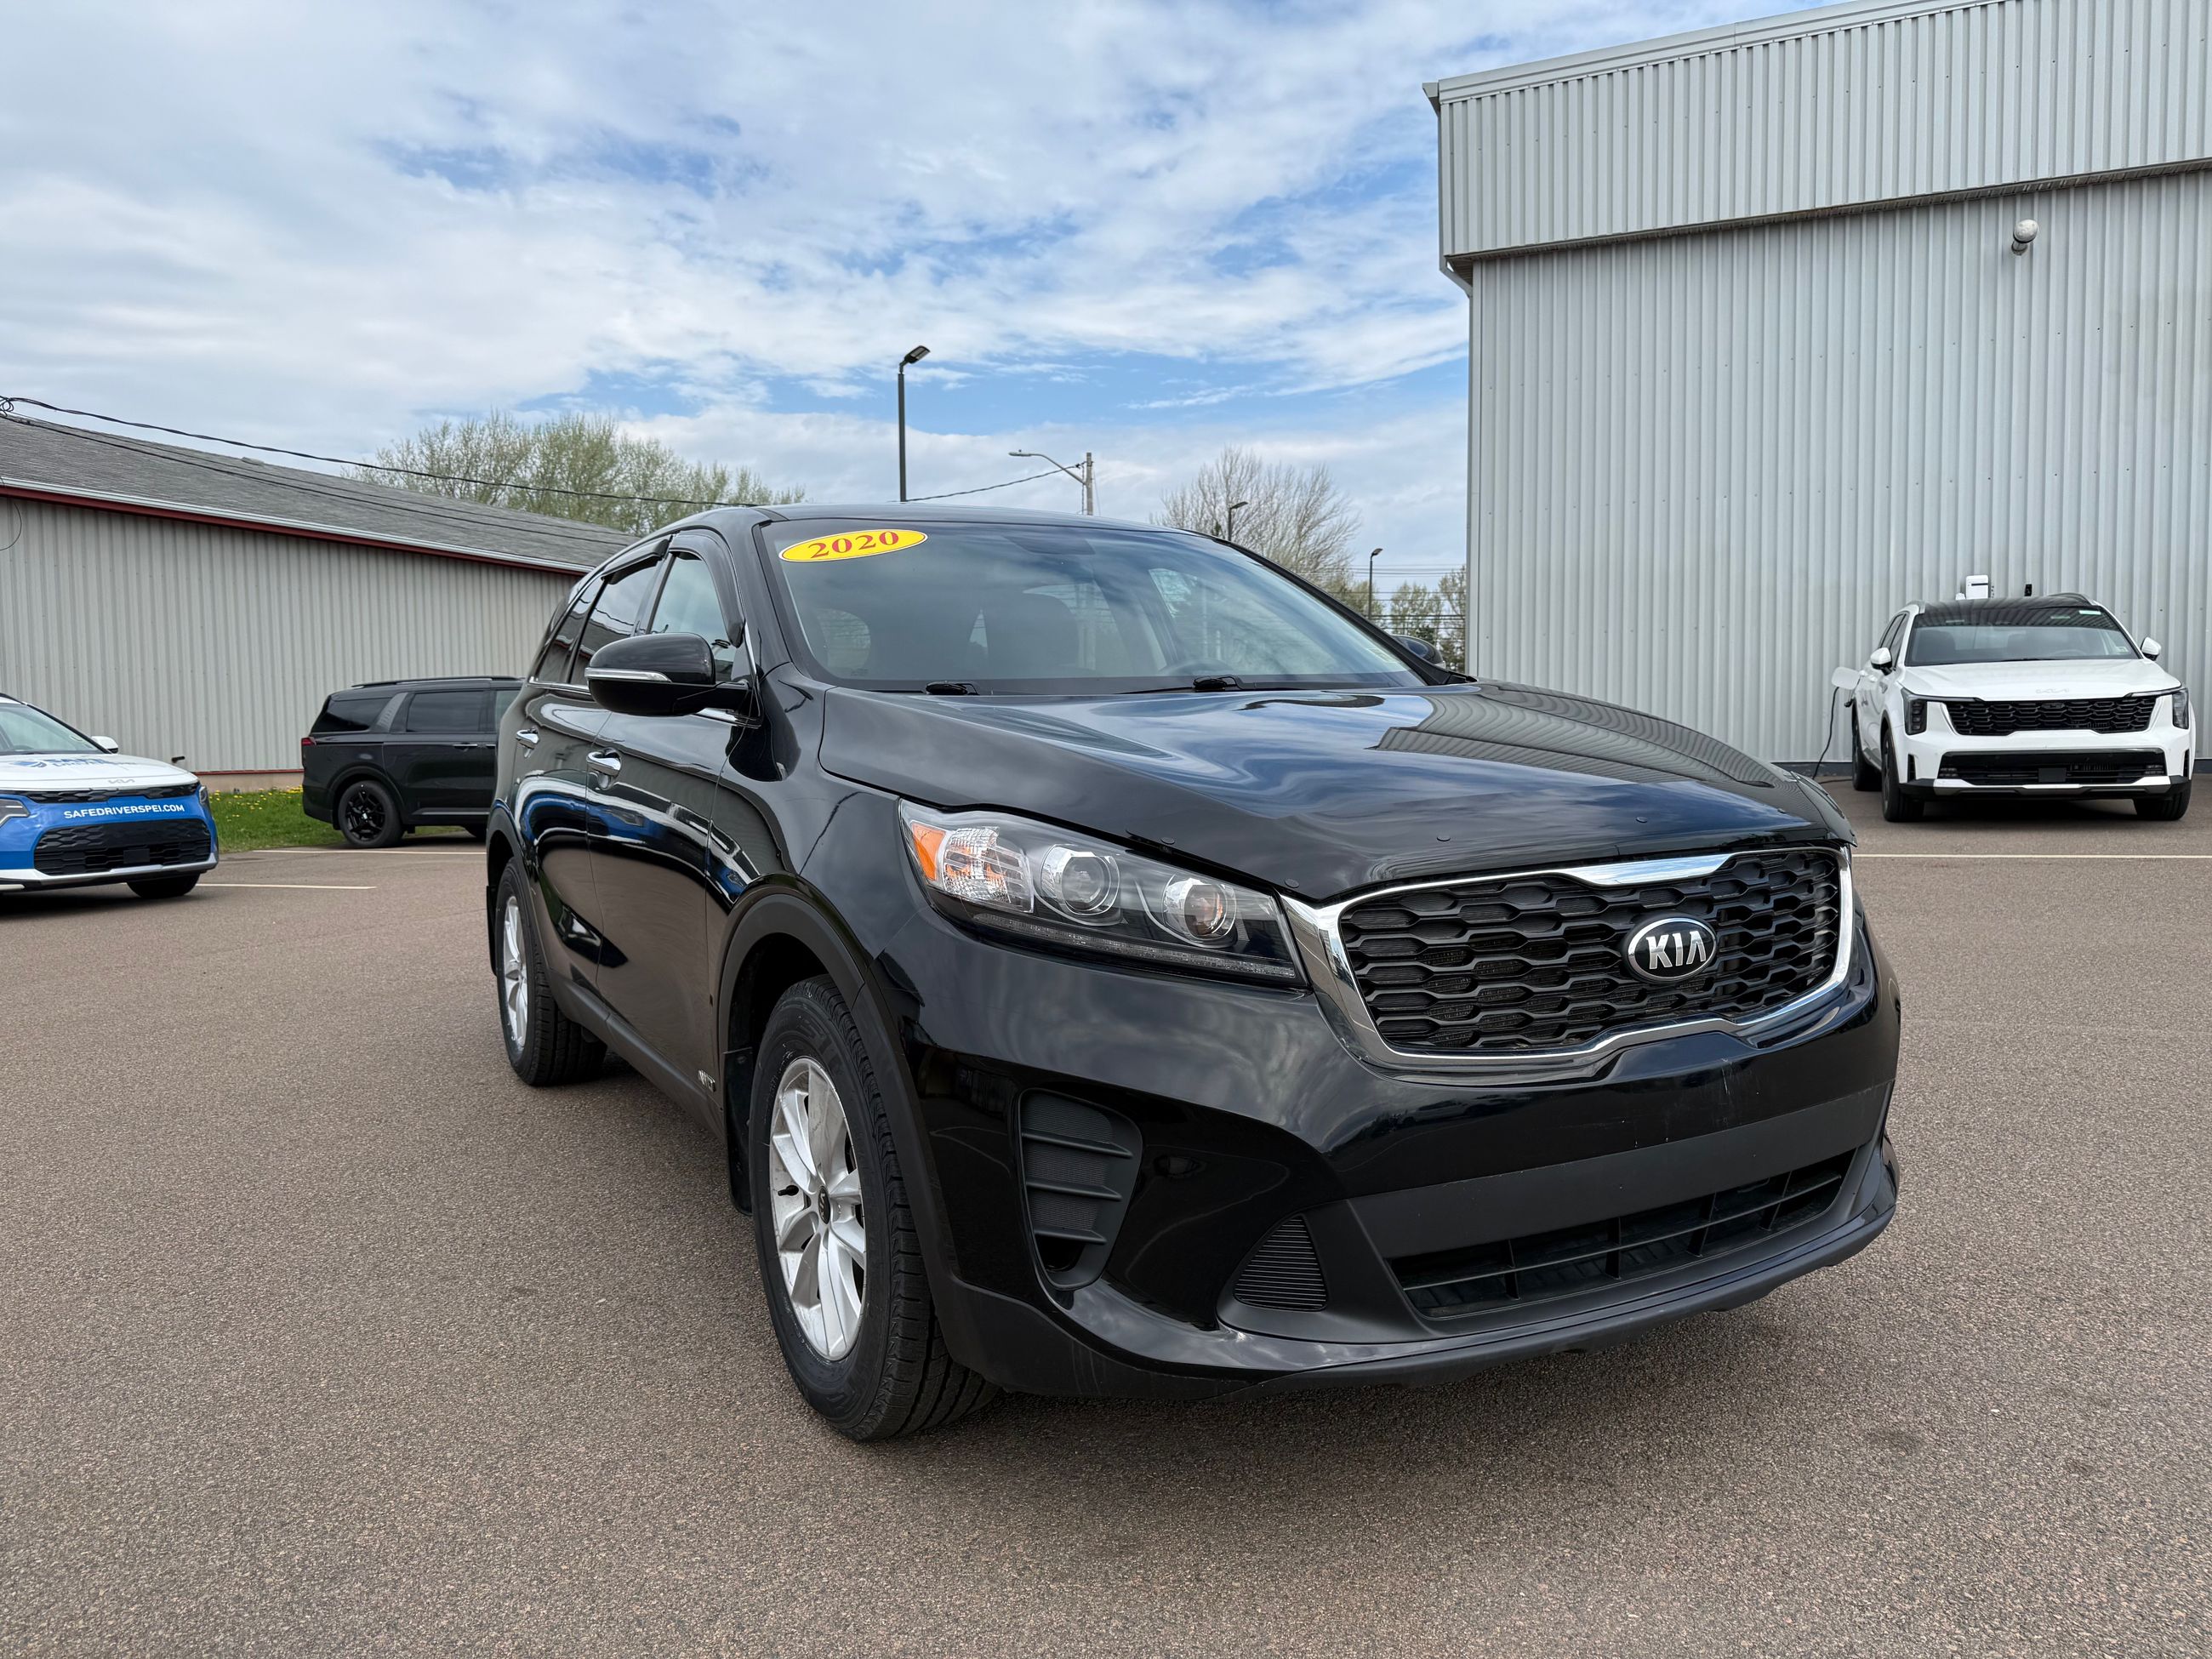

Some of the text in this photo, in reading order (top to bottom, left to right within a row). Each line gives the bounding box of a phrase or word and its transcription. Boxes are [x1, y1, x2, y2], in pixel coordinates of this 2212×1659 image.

[808, 532, 899, 558] 2020
[64, 805, 185, 818] SAFEDRIVERSPEI.COM
[1646, 931, 1707, 969] KIA
